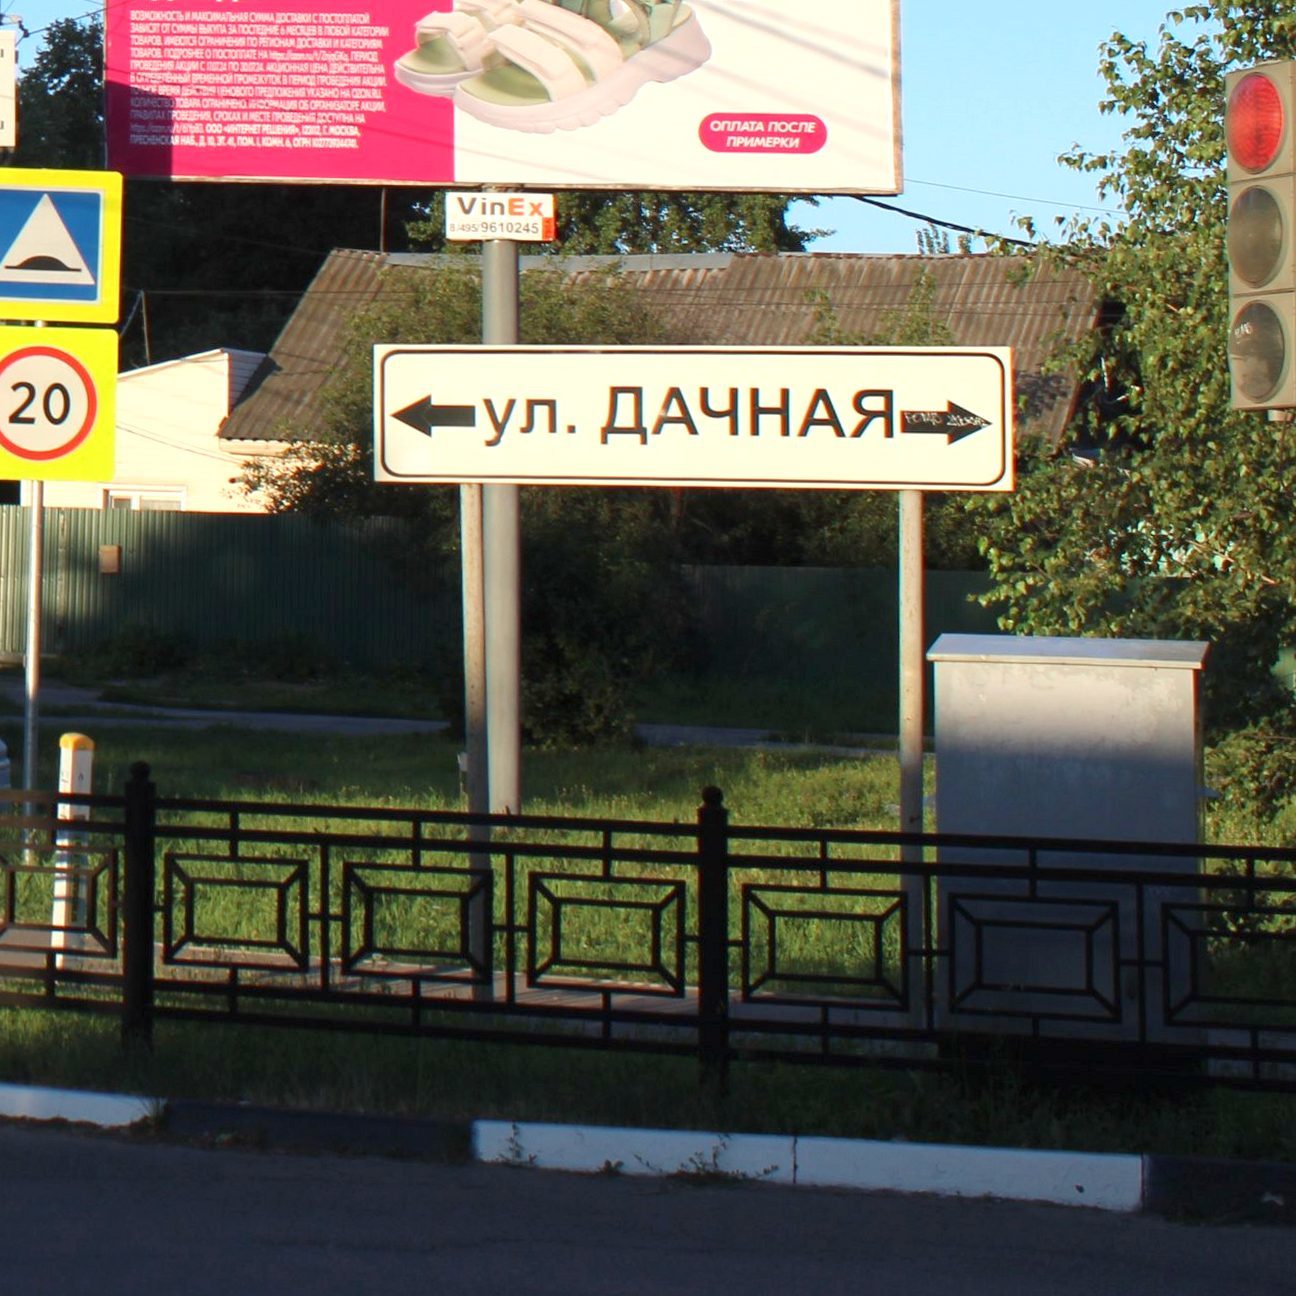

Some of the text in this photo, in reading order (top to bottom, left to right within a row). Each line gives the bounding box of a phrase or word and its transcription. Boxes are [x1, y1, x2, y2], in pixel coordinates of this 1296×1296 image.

[710, 120, 817, 134] ОПЛАТА ПОСЛЕ
[726, 136, 801, 149] ПРИМЕРКИ
[457, 196, 545, 217] VinEx
[481, 221, 540, 235] 9610245
[8, 381, 71, 425] 20
[483, 385, 895, 446] ул. ДАЧНАЯ
